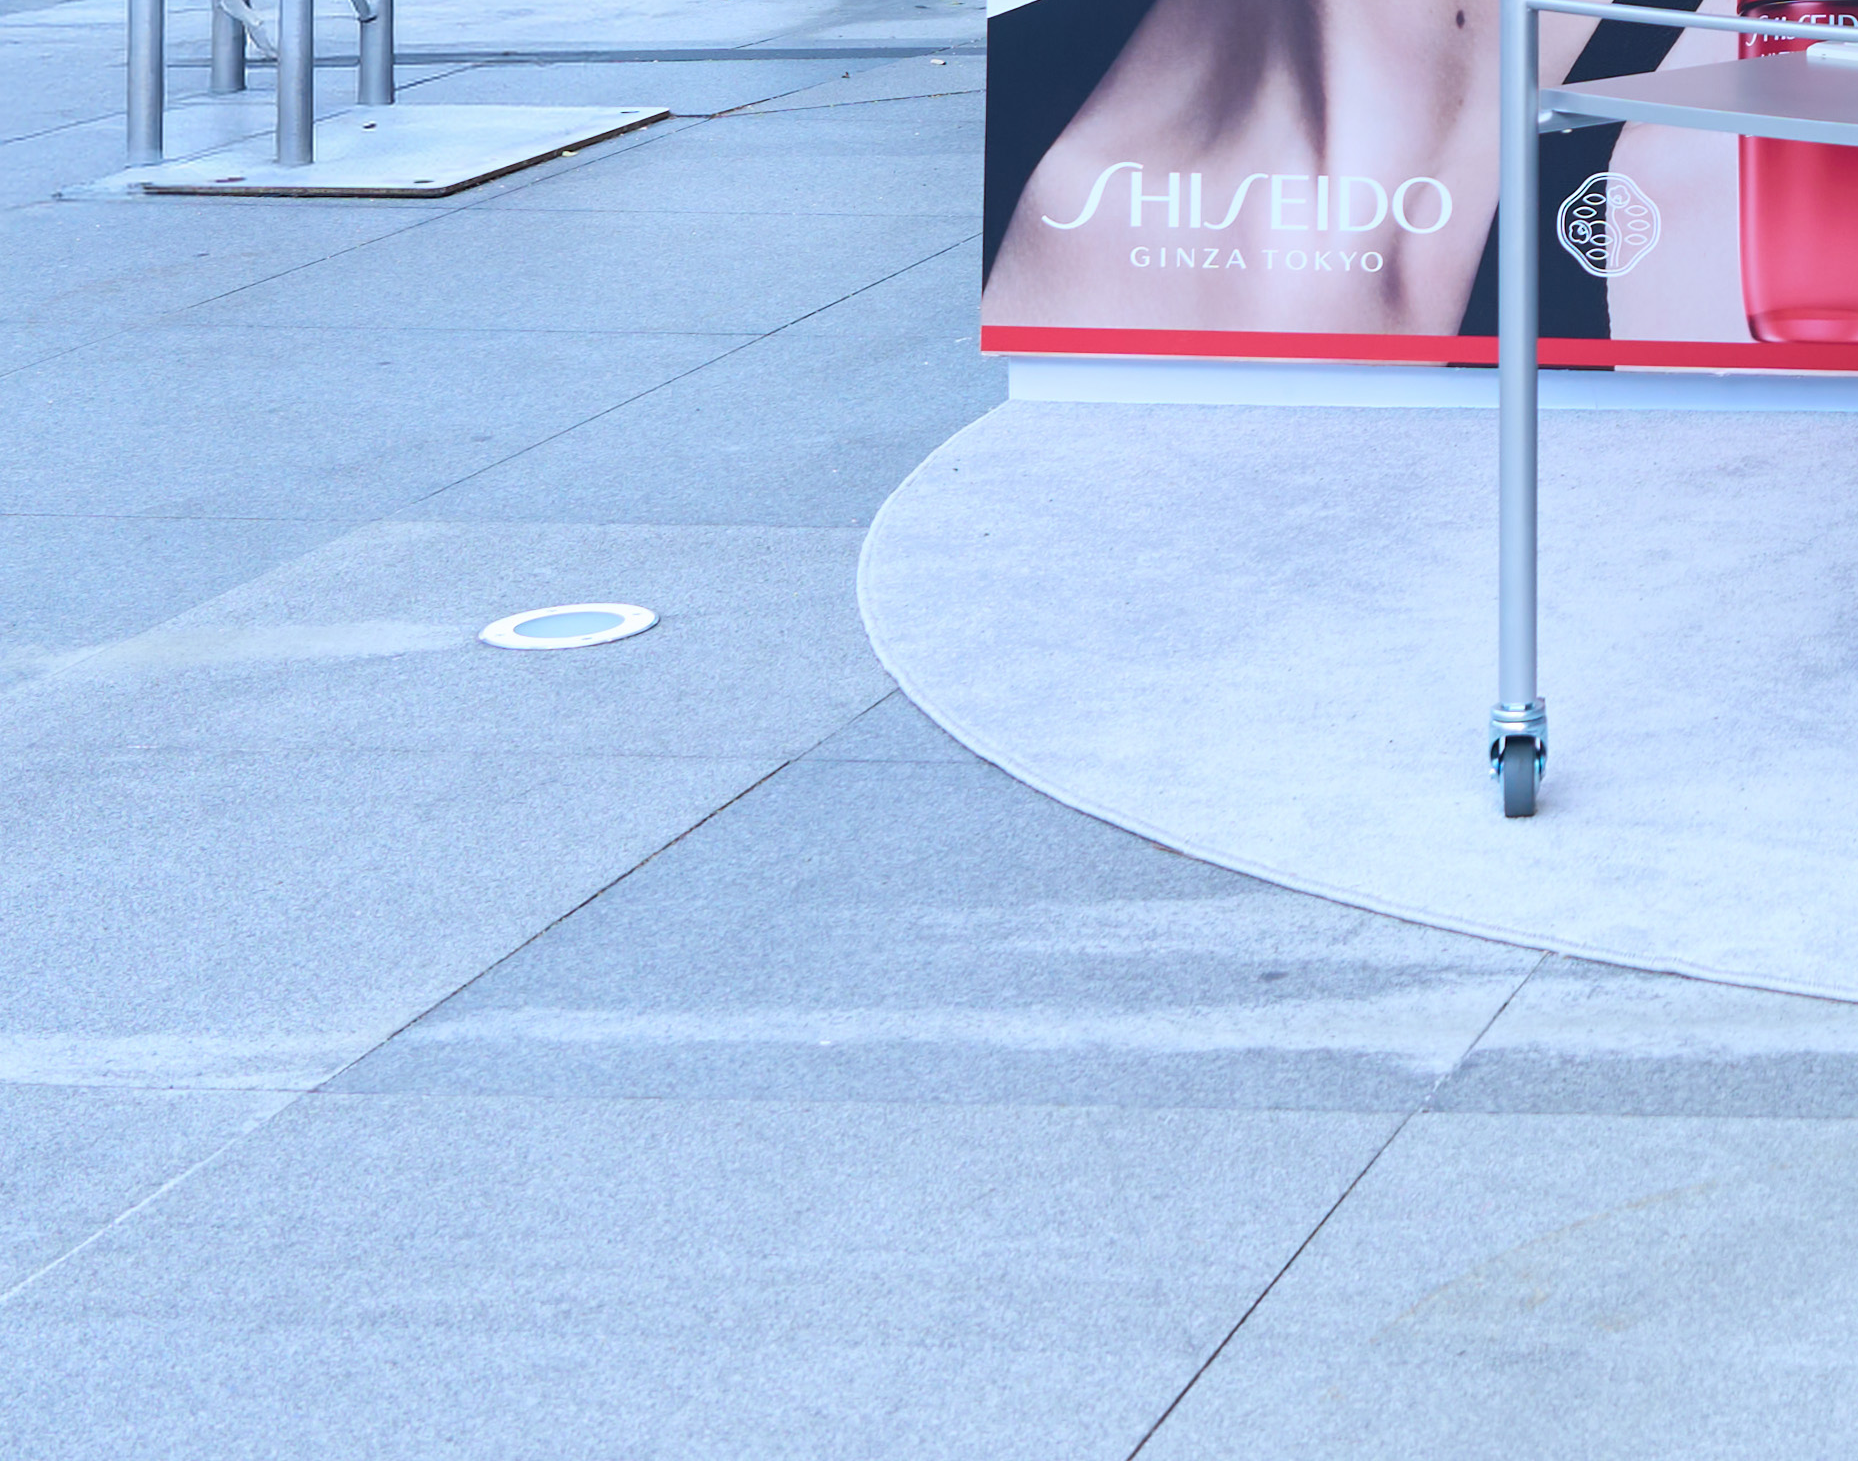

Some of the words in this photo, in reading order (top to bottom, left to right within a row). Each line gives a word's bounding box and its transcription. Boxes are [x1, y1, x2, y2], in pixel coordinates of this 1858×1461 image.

[1041, 161, 1453, 234] SHISEIDO
[1130, 246, 1247, 269] GINZA
[1262, 249, 1384, 272] TOKYO
